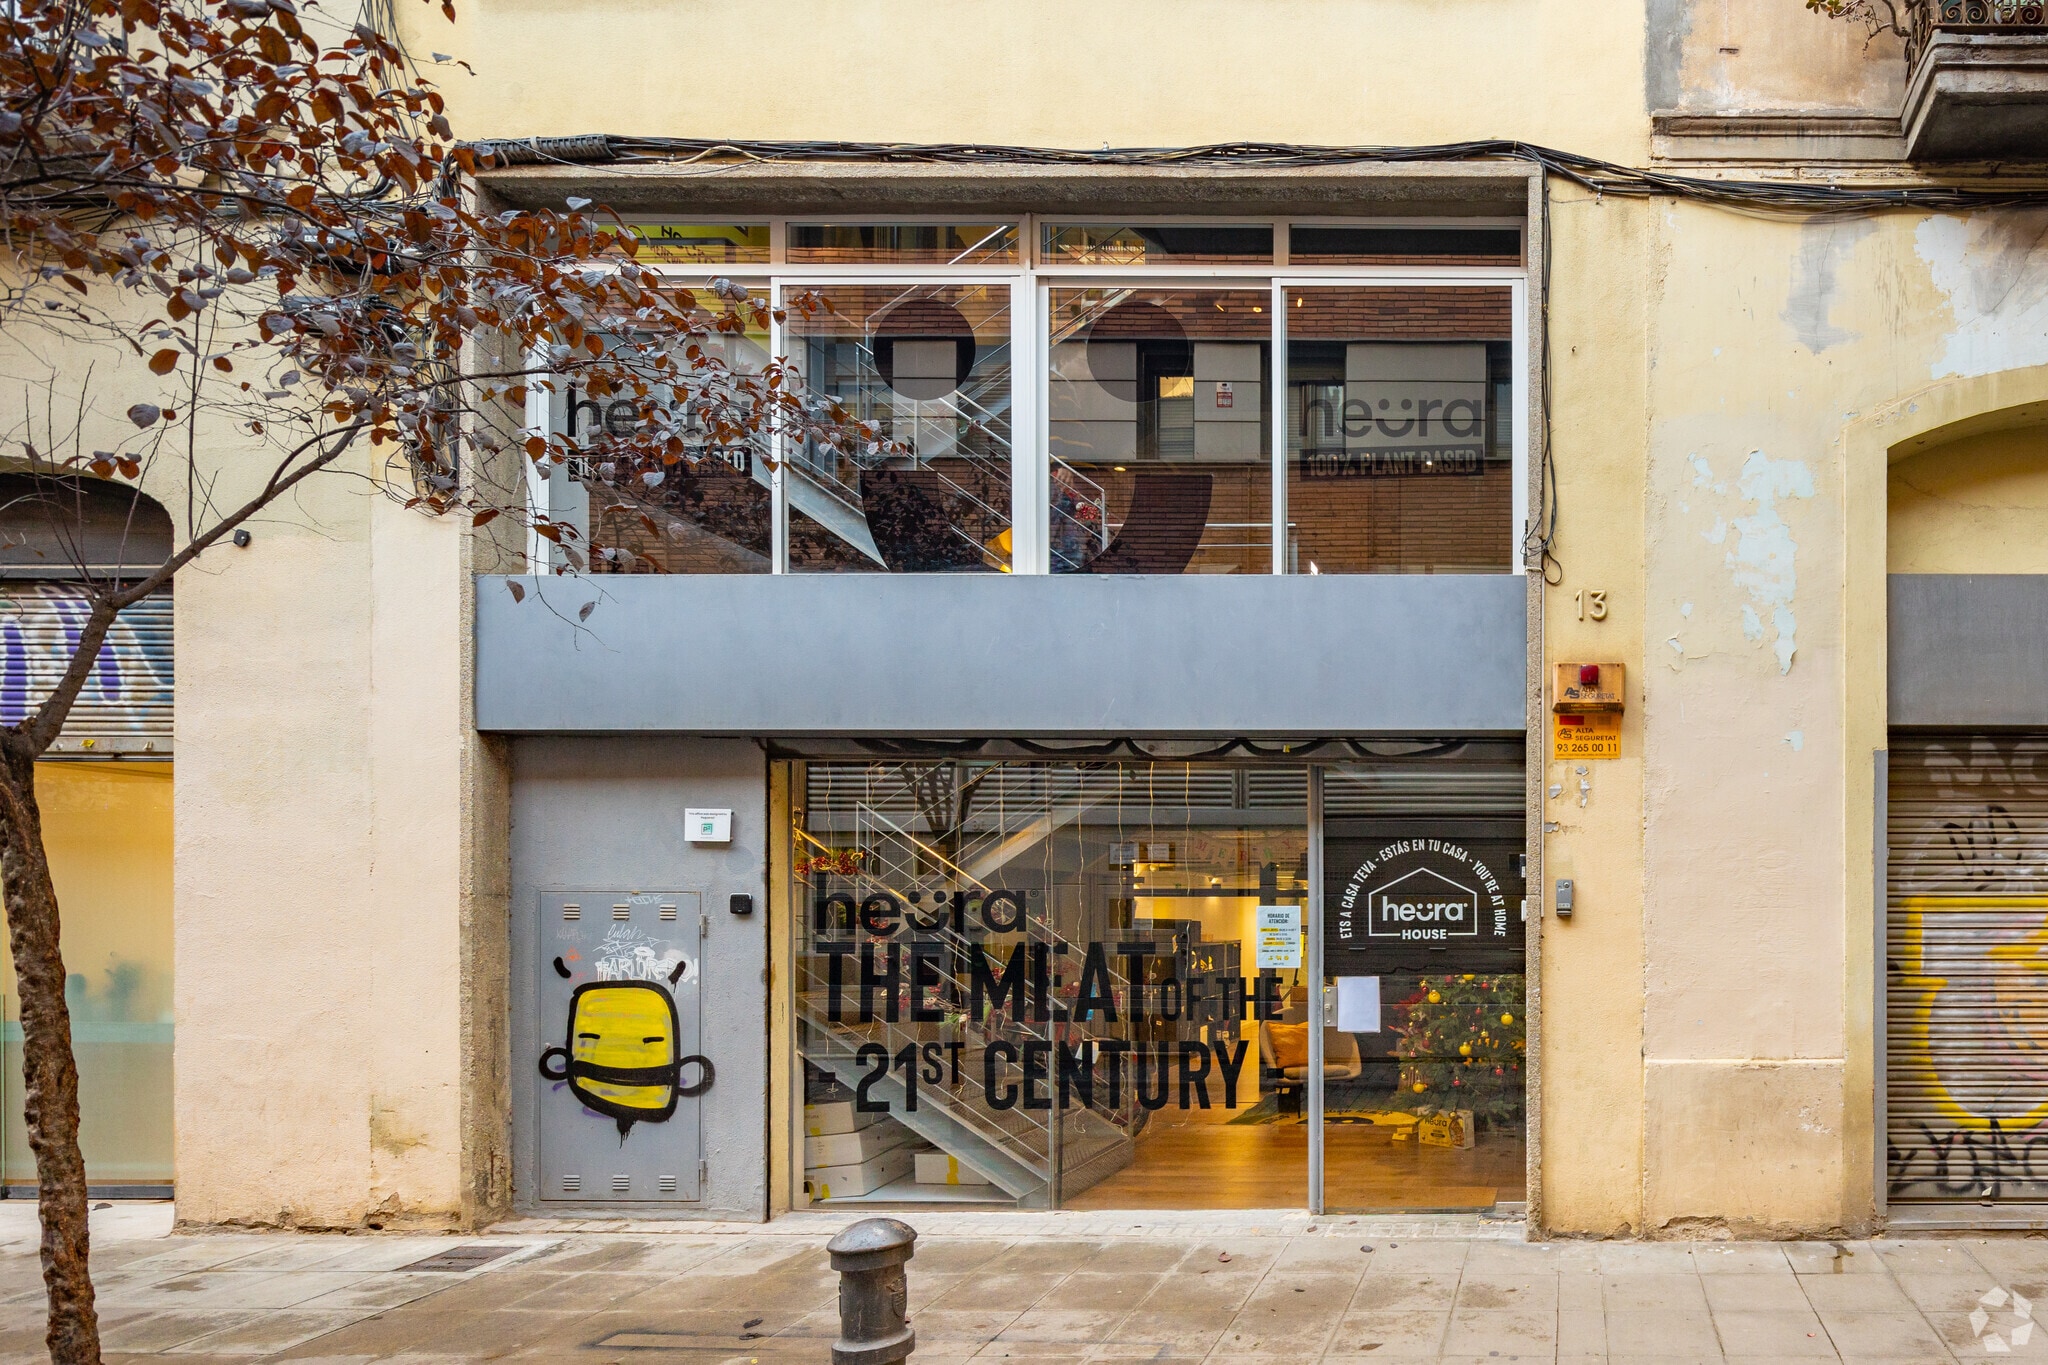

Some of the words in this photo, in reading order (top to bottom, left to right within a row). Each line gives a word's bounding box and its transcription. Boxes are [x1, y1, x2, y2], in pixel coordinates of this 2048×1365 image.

[1575, 589, 1608, 622] 13
[1556, 743, 1569, 752] 93
[1571, 743, 1589, 752] 265
[1591, 743, 1604, 752] 00
[1607, 743, 1617, 752] 11
[1379, 840, 1410, 862] ESTÁS
[1412, 839, 1425, 851] EN
[1428, 839, 1441, 852] TU
[1442, 842, 1468, 863] CASA
[1353, 860, 1377, 883] TEVA
[1472, 860, 1500, 894] YOU'RE
[1341, 882, 1361, 909] CASA
[1490, 894, 1505, 906] AT
[1339, 920, 1353, 939] ETS
[1493, 908, 1507, 937] HOME
[1402, 929, 1447, 940] HOUSE
[816, 942, 945, 1022] THE
[970, 941, 1156, 1022] MEAT
[1161, 978, 1205, 1022] OF
[1215, 977, 1284, 1021] THE
[855, 1041, 965, 1113] 21ST
[984, 1040, 1250, 1111] CENTURY
